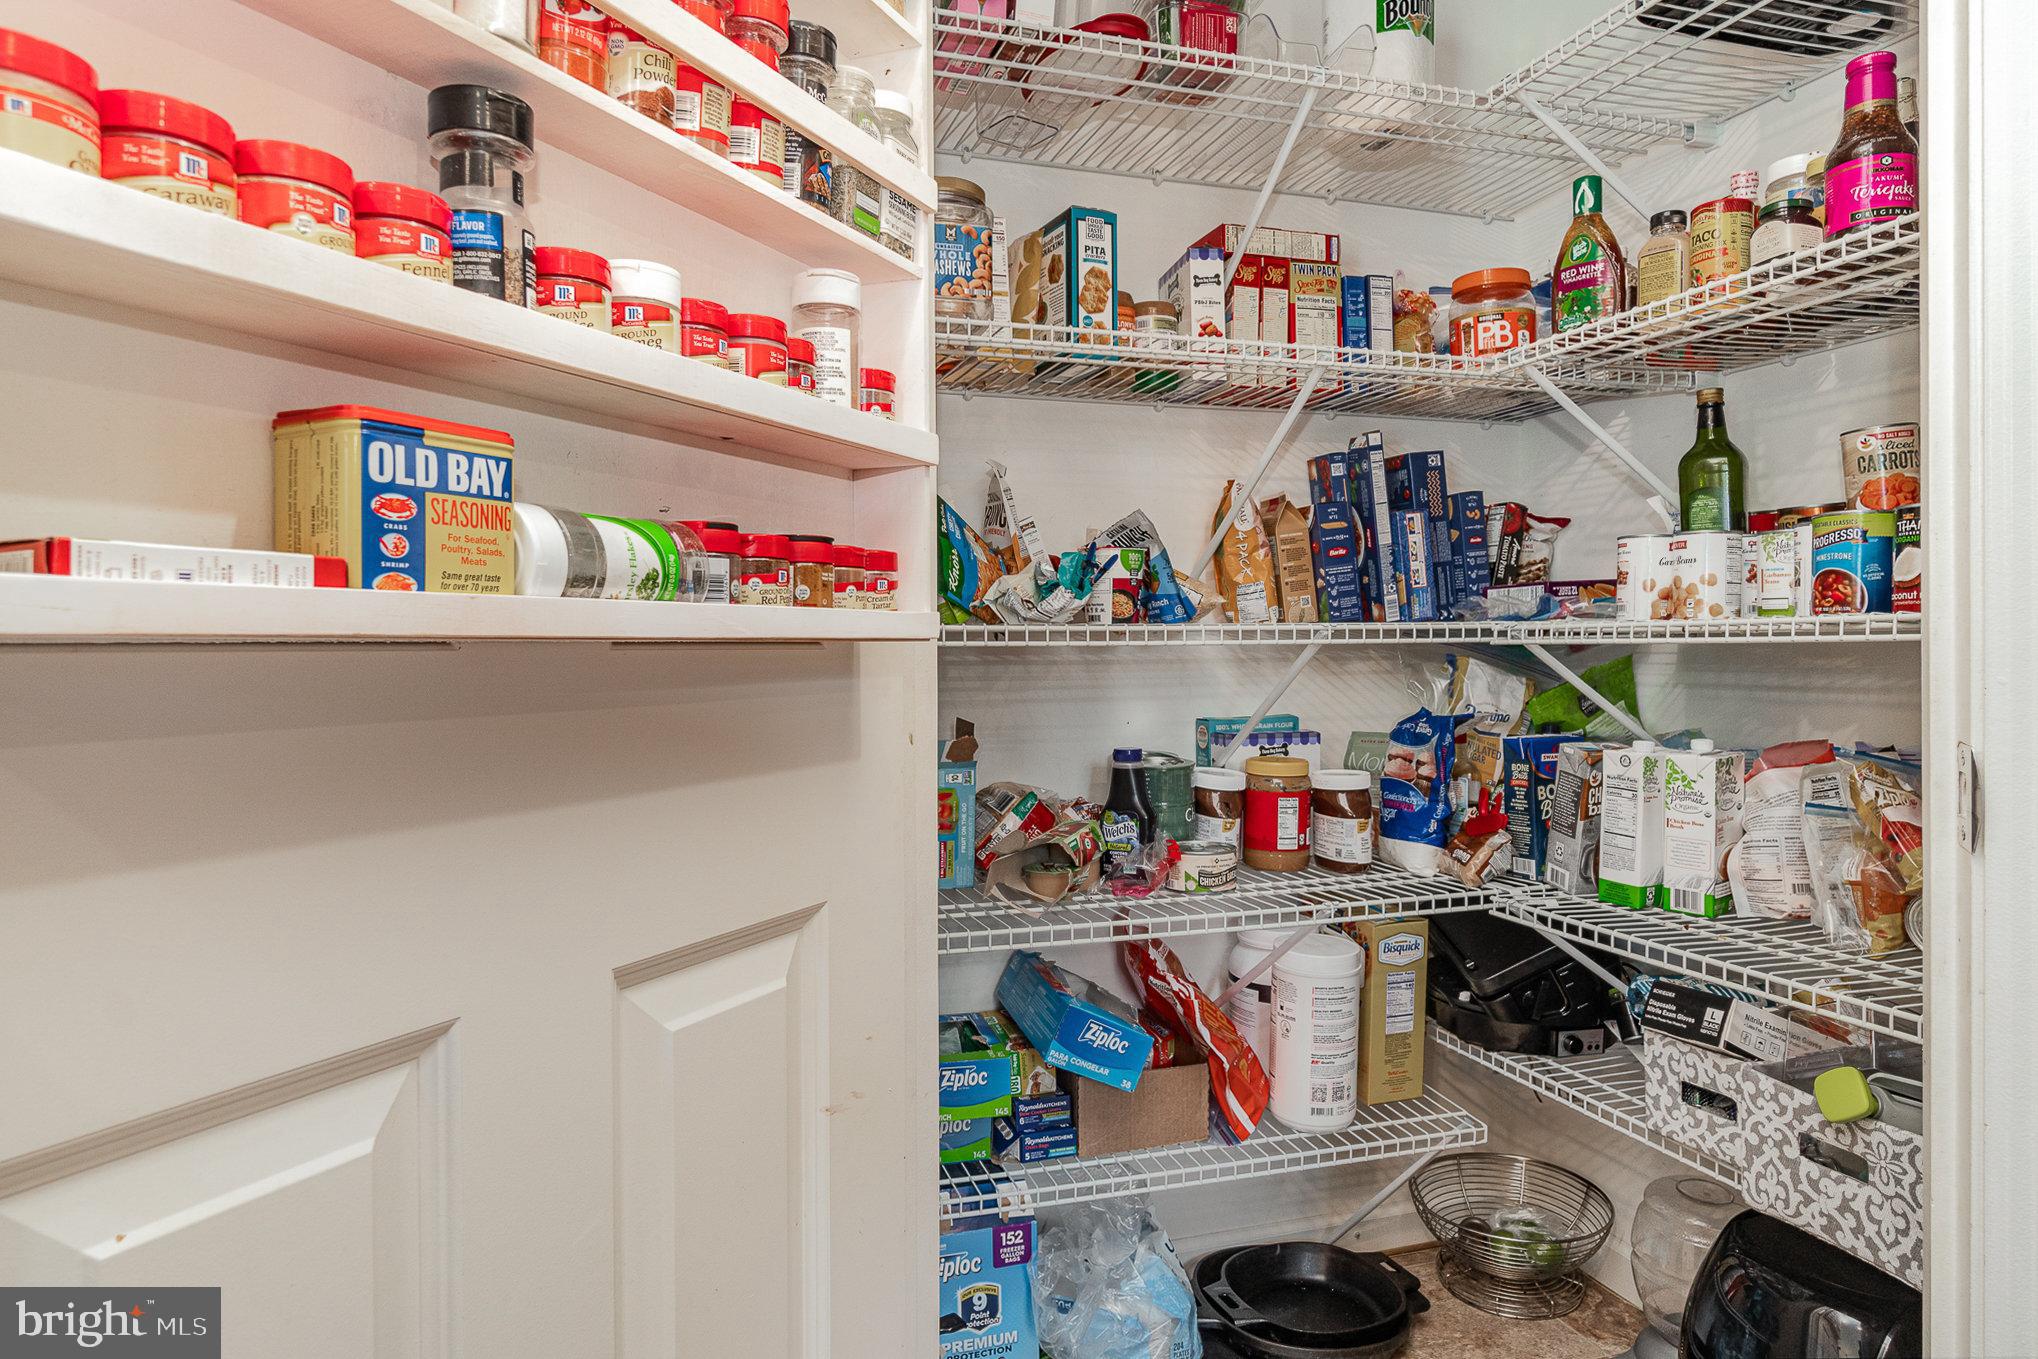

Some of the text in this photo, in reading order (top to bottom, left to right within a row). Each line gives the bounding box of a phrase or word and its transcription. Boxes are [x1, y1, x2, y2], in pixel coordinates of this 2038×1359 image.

[644, 54, 672, 71] Chili
[634, 67, 676, 88] Powder
[1870, 173, 1904, 182] TAKUMI
[1850, 180, 1915, 202] Teriyaki
[1855, 207, 1913, 220] ORIGINAL
[452, 221, 486, 231] FLAVOR
[1087, 217, 1104, 225] FOOD
[1087, 232, 1104, 240] GOOD
[1692, 228, 1719, 248] TACO
[1084, 245, 1107, 256] PITA
[401, 262, 450, 281] Fennel
[935, 260, 972, 276] ASHEWS
[1292, 263, 1339, 277] TWIN PACK
[1561, 262, 1606, 280] RED WINE
[1563, 272, 1602, 285] VINAIGRETTE
[1477, 320, 1513, 350] PB
[1484, 336, 1496, 349] fit
[1885, 431, 1898, 439] SALT
[1857, 450, 1920, 475] CARROTS
[367, 440, 509, 499] OLD BAY
[430, 498, 512, 532] SEASONING
[384, 522, 408, 531] CRABS
[448, 533, 463, 543] For
[1813, 527, 1862, 549] PROGRESSO
[625, 536, 637, 568] Flakes
[1236, 531, 1254, 578] 4 PACK
[1328, 548, 1347, 557] Barilla
[1497, 536, 1512, 579] TOMATO PASTE
[1816, 552, 1853, 562] MINESTRONE
[380, 561, 409, 569] SHRIMP
[460, 557, 488, 567] Meats
[948, 548, 961, 592] Knorr
[441, 571, 502, 584] Same great taste
[440, 581, 500, 594] for over 70 years
[762, 595, 778, 605] Red
[1274, 721, 1294, 729] FLOUR
[1467, 740, 1502, 761] NULATED
[1542, 754, 1560, 762] SWAN
[1511, 763, 1530, 772] BONE
[1606, 774, 1638, 784] Nutrition Facts
[1810, 776, 1826, 784] Nutrition
[1537, 784, 1556, 801] BO
[1670, 785, 1705, 799] Nature's
[1670, 794, 1709, 806] Promise
[960, 802, 967, 813] GO
[1674, 803, 1700, 811] Organic
[960, 826, 967, 836] ON
[1103, 821, 1136, 840] Welch's
[1199, 872, 1225, 887] CHICKEN
[1383, 940, 1421, 955] Bisquick
[1648, 998, 1677, 1011] Disposable
[1646, 1005, 1663, 1016] Nitrile
[1663, 1010, 1677, 1019] Exam
[1676, 1013, 1696, 1024] Gloves
[1709, 1011, 1716, 1022] L
[1702, 1020, 1720, 1031] BLACK
[1744, 1013, 1823, 1051] Nitrile Gloves
[1082, 1020, 1130, 1055] Ziploc
[1049, 1050, 1111, 1078] PARA CONGELAR
[940, 1069, 989, 1093] Ziploc
[1011, 1076, 1021, 1094] 180
[1120, 1080, 1132, 1090] 38
[994, 1107, 1009, 1116] 145
[1018, 1103, 1042, 1113] Reynolds
[938, 1118, 972, 1139] ploc
[1024, 1133, 1074, 1146] Reynolds KITCHENS
[972, 1150, 987, 1160] 145
[1024, 1152, 1030, 1160] 5
[1000, 1230, 1024, 1246] 152
[1000, 1245, 1025, 1255] FREEZER
[1000, 1250, 1025, 1260] GALLON
[1004, 1255, 1020, 1264] BAGS
[939, 1255, 982, 1284] iploc
[972, 1294, 988, 1312] 9
[969, 1311, 990, 1321] Point
[940, 1330, 1019, 1352] PREMIUM
[946, 1344, 1014, 1359] PROTECTION
